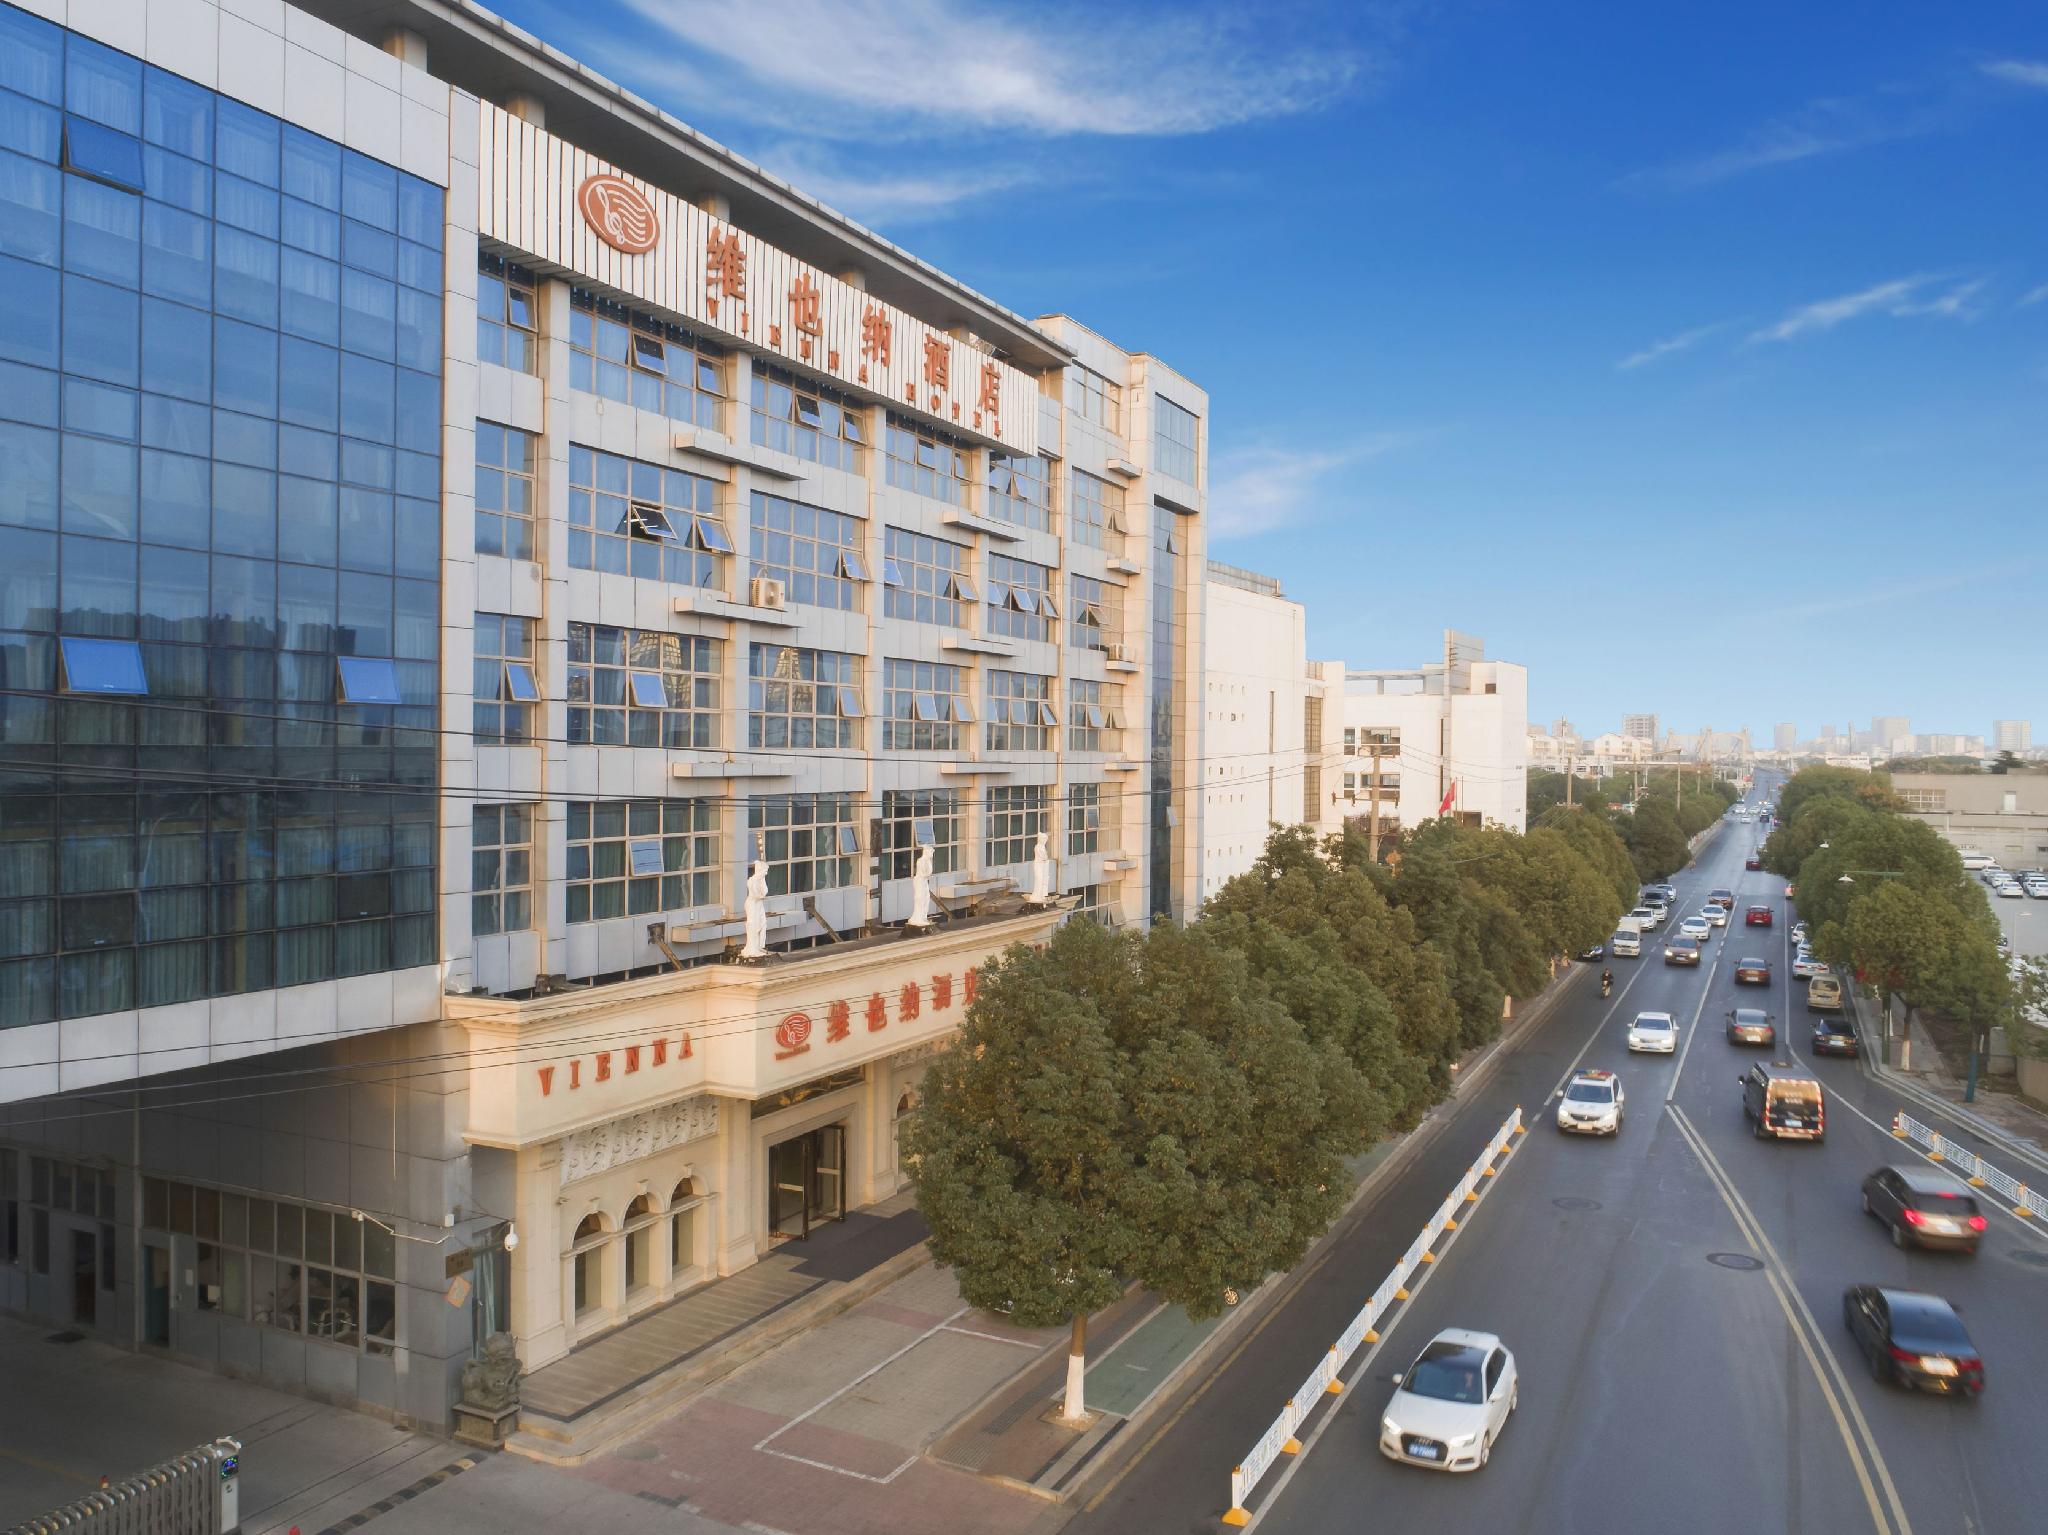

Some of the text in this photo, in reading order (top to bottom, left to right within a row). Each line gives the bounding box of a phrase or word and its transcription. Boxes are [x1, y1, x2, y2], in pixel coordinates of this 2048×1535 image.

[706, 226, 1001, 416] 维也纳酒店
[707, 297, 1001, 437] VIENNA HOTEL
[537, 1032, 693, 1096] VIENNA
